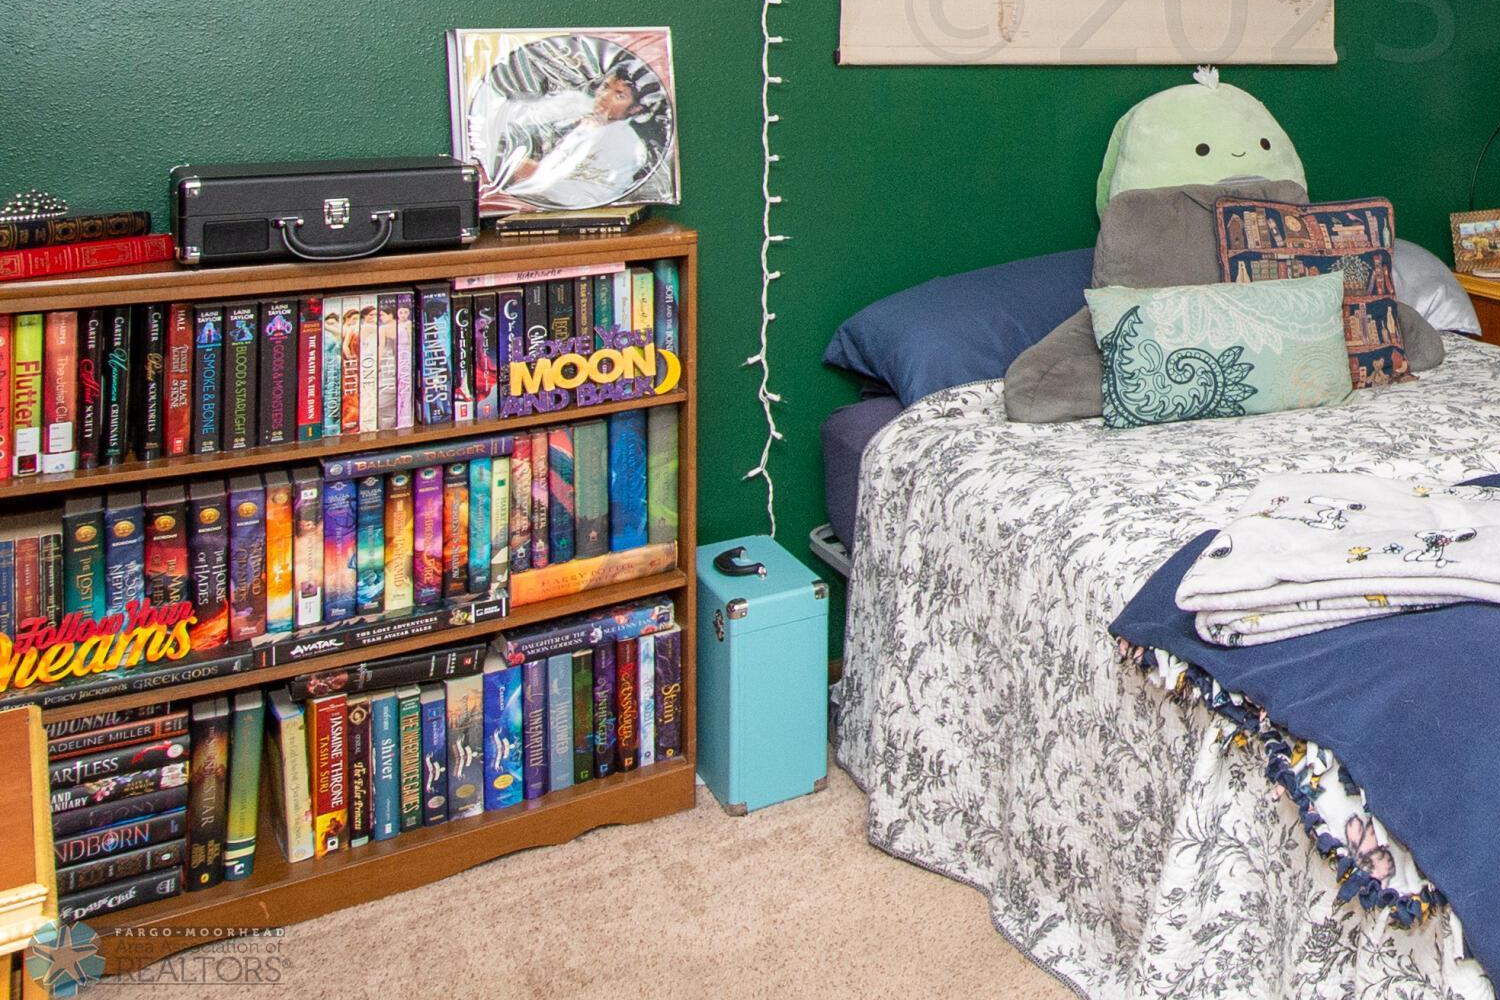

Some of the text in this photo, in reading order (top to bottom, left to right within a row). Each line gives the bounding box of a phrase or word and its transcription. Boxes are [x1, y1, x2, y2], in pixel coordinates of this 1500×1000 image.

[665, 285, 673, 302] SOFI
[87, 319, 98, 349] CARTER
[113, 316, 124, 347] CARTER
[150, 312, 161, 342] CARTER
[177, 310, 185, 332] HALE
[272, 344, 284, 371] GODS
[455, 308, 470, 378] Cinder
[56, 356, 68, 376] The
[235, 346, 247, 380] BLOOD
[344, 360, 357, 396] ELITE
[362, 357, 375, 390] ONE
[381, 356, 395, 394] HEIR
[400, 350, 411, 395] CROWN
[424, 321, 448, 404] RENEGADES
[510, 343, 656, 397] MOON
[15, 361, 41, 428] Flutter
[56, 377, 68, 404] Juliet
[170, 386, 179, 409] STONE
[179, 379, 188, 407] PALACE
[202, 354, 215, 434] SMOKE & BONE
[272, 380, 283, 429] MONSTERS
[327, 360, 338, 418] SELECTION
[500, 376, 656, 418] AND BACK
[55, 406, 68, 423] Clu
[84, 405, 93, 439] SOCIETY
[109, 404, 120, 446] CRIMINALS
[147, 383, 157, 432] SCOUNDRELS
[235, 388, 246, 435] STARLIGHT
[355, 444, 486, 471] BALLAD DAGGER
[194, 552, 210, 605] OF HADES
[211, 549, 227, 604] THE HOUSE
[451, 545, 460, 578] SHADOW
[76, 573, 95, 601] LOST
[108, 564, 125, 614] NEPTUN
[145, 569, 165, 608] ATHEN
[167, 574, 184, 604] MAR
[14, 597, 195, 654] Follow Your
[356, 617, 438, 638] THE LOST ADVENTURES
[383, 630, 409, 641] AVATAR
[411, 625, 432, 635] TALES
[522, 630, 587, 651] DAUGHTER OF THE
[290, 639, 344, 656] AVATAR
[526, 638, 584, 656] MOON GODDESS
[44, 665, 219, 706] PERCY JACKSON'S GREEK GODS
[658, 683, 680, 724] Stain
[330, 717, 343, 759] JASMINE
[402, 712, 419, 730] THE
[525, 708, 545, 768] UNEARTHLY
[555, 702, 569, 755] HALLOWED
[48, 726, 152, 754] ADELINE MILLER
[205, 740, 218, 770] SUN
[401, 731, 420, 780] INHERITANCE
[51, 756, 119, 784] ARTLESS
[319, 735, 330, 794] TASHA SURI
[381, 738, 395, 781] shiver
[329, 760, 343, 808] THRONE
[353, 762, 366, 830] The False Princess
[402, 781, 419, 814] GAMES
[50, 796, 89, 812] NUARY
[200, 785, 216, 828] STAR
